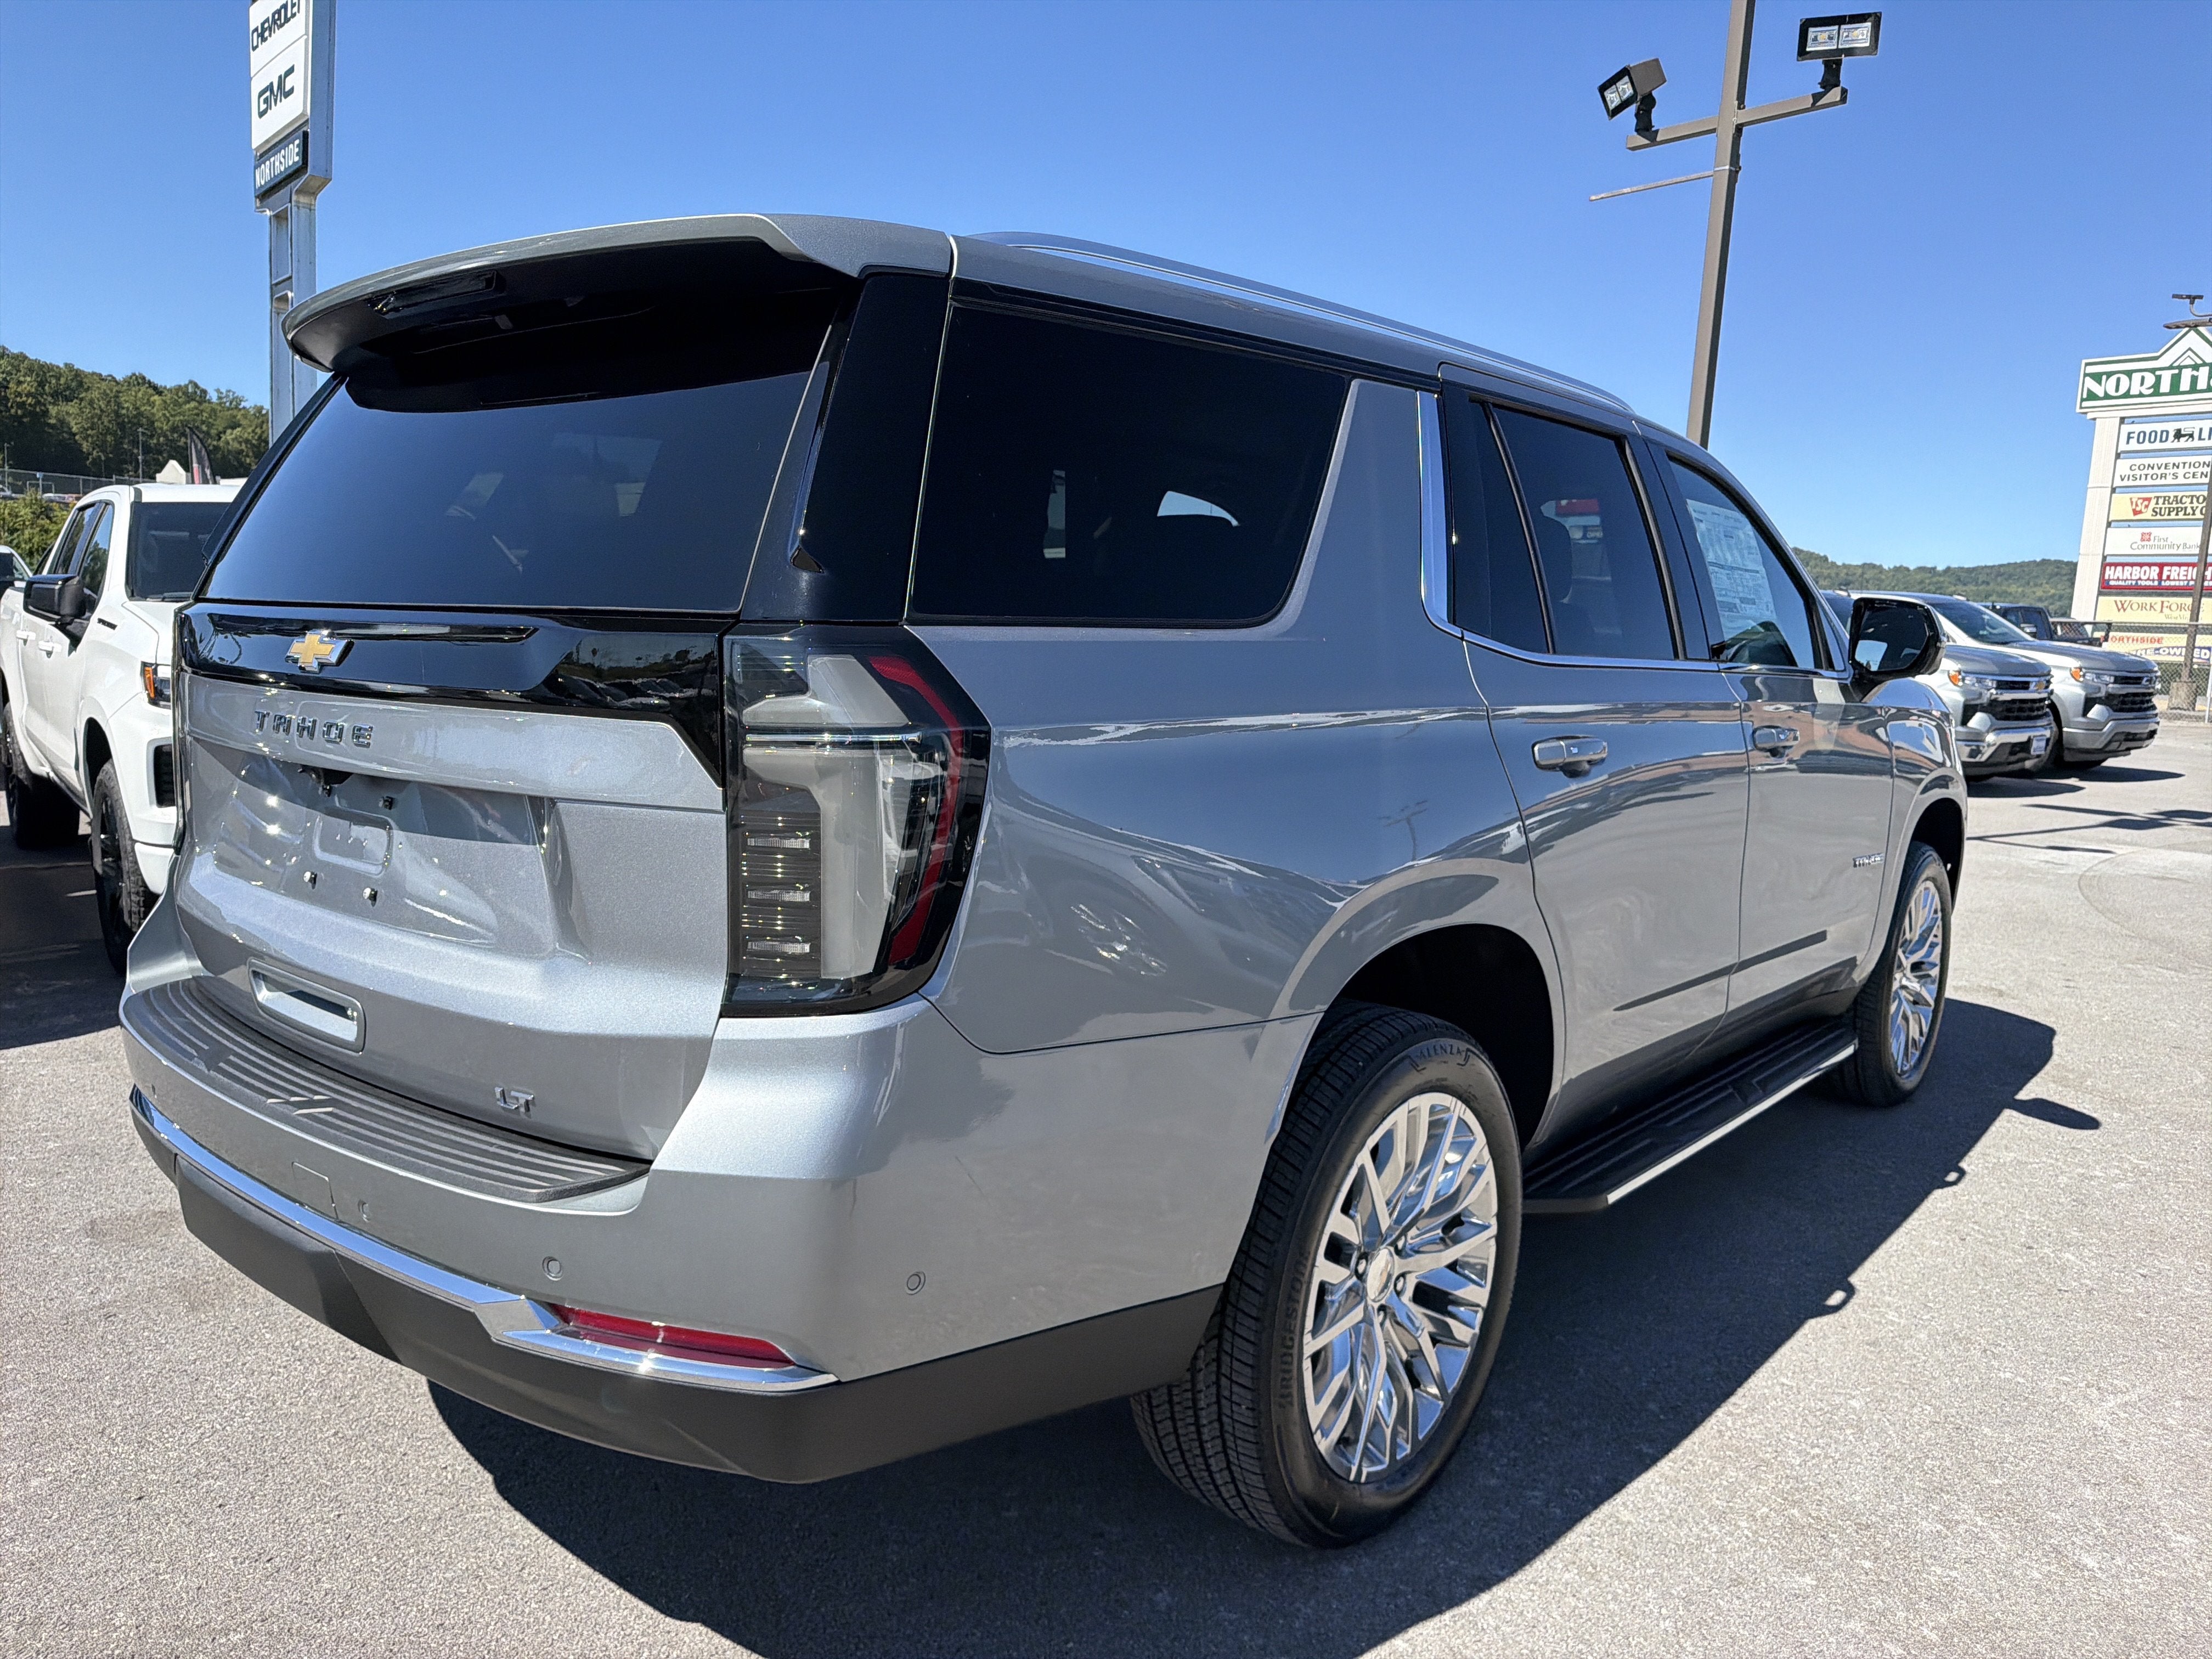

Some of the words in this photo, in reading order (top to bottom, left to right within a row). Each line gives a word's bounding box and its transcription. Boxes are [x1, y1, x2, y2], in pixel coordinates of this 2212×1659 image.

[258, 64, 295, 119] GMC
[255, 139, 300, 189] NORTHSIDE
[2083, 366, 2212, 399] NORTH
[2126, 430, 2170, 445] FOOD
[2129, 460, 2211, 472] CONVENTION
[2119, 472, 2179, 482] VISITOR'S
[2153, 494, 2207, 506] TRACTO
[2151, 506, 2199, 517] SUPPLY
[2130, 541, 2182, 551] Community
[2153, 535, 2169, 543] First
[2104, 566, 2160, 580] HARBOR
[255, 709, 374, 748] TAHOE
[494, 1086, 534, 1114] LT
